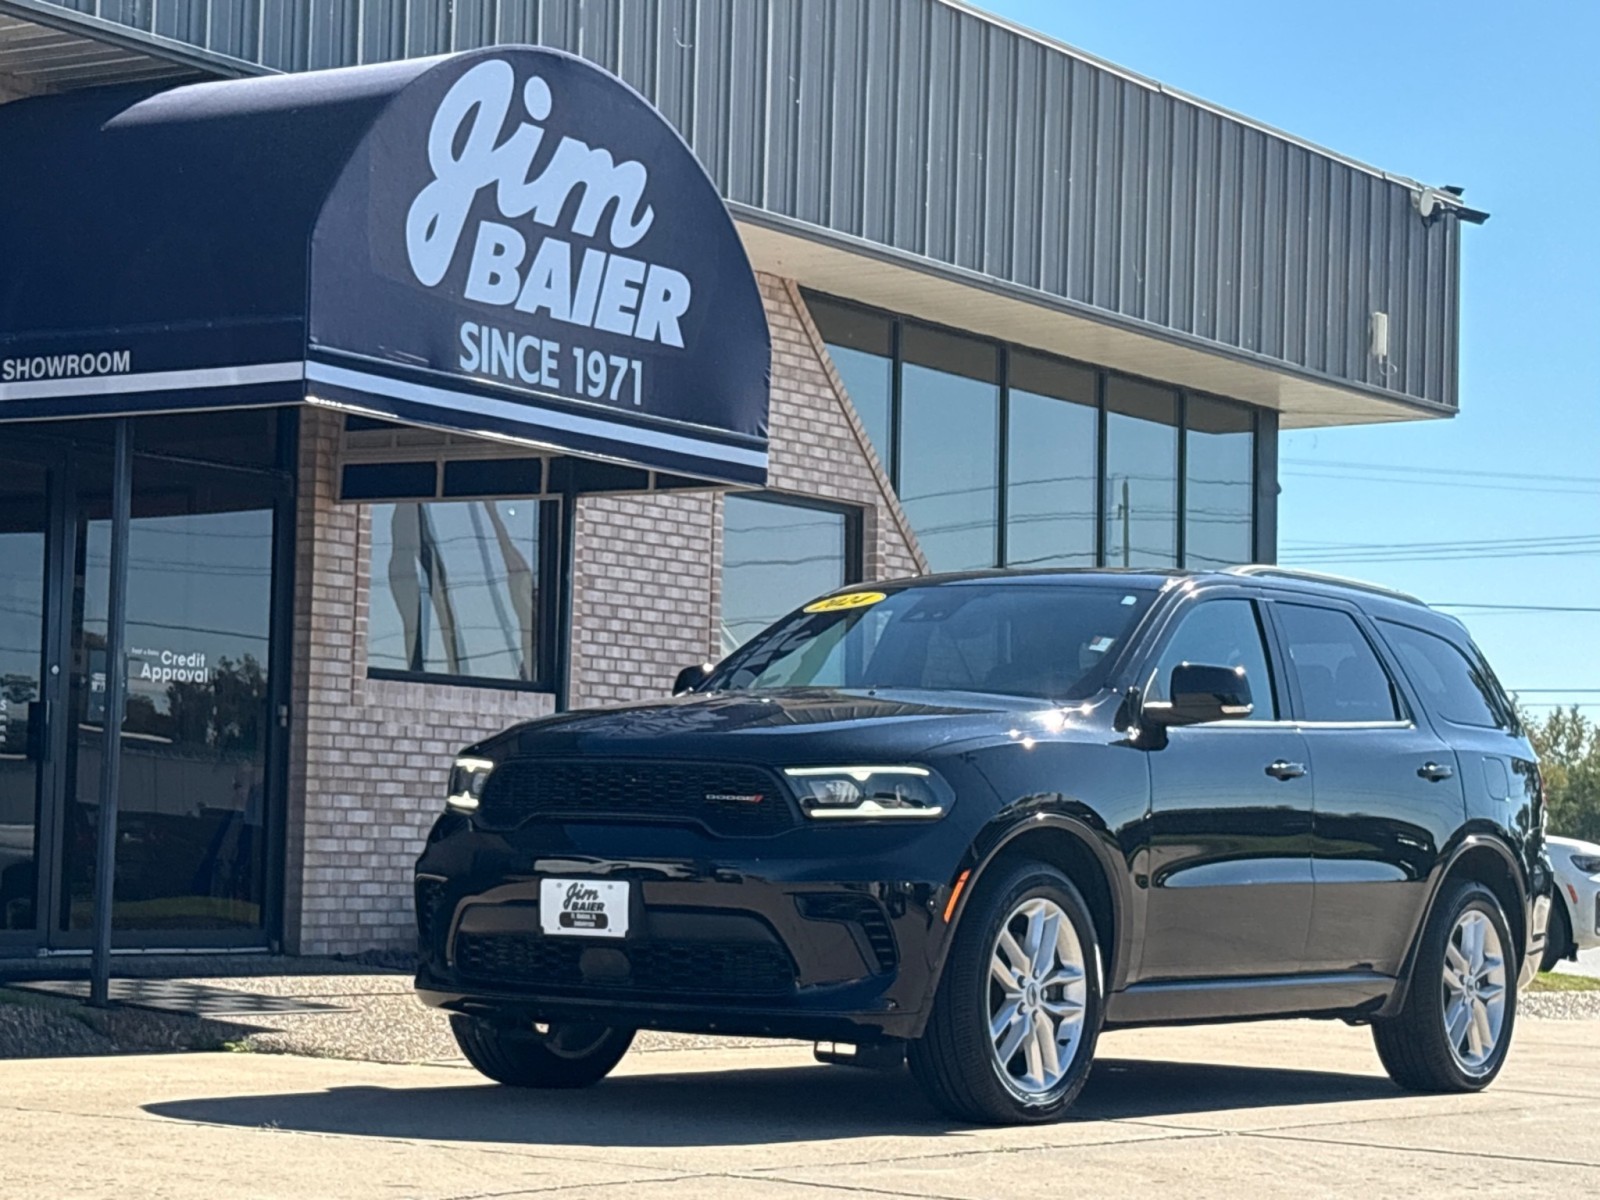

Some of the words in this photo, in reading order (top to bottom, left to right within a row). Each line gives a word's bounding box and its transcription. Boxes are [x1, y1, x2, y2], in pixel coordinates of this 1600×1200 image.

[406, 59, 655, 287] Jim
[464, 220, 691, 348] BAIER
[2, 350, 131, 380] SHOWROOM
[459, 321, 561, 389] SINCE
[573, 347, 643, 406] 1971
[140, 662, 209, 683] Approval
[161, 650, 206, 668] Credit
[563, 882, 599, 910] Jim
[571, 901, 605, 912] BAIER
